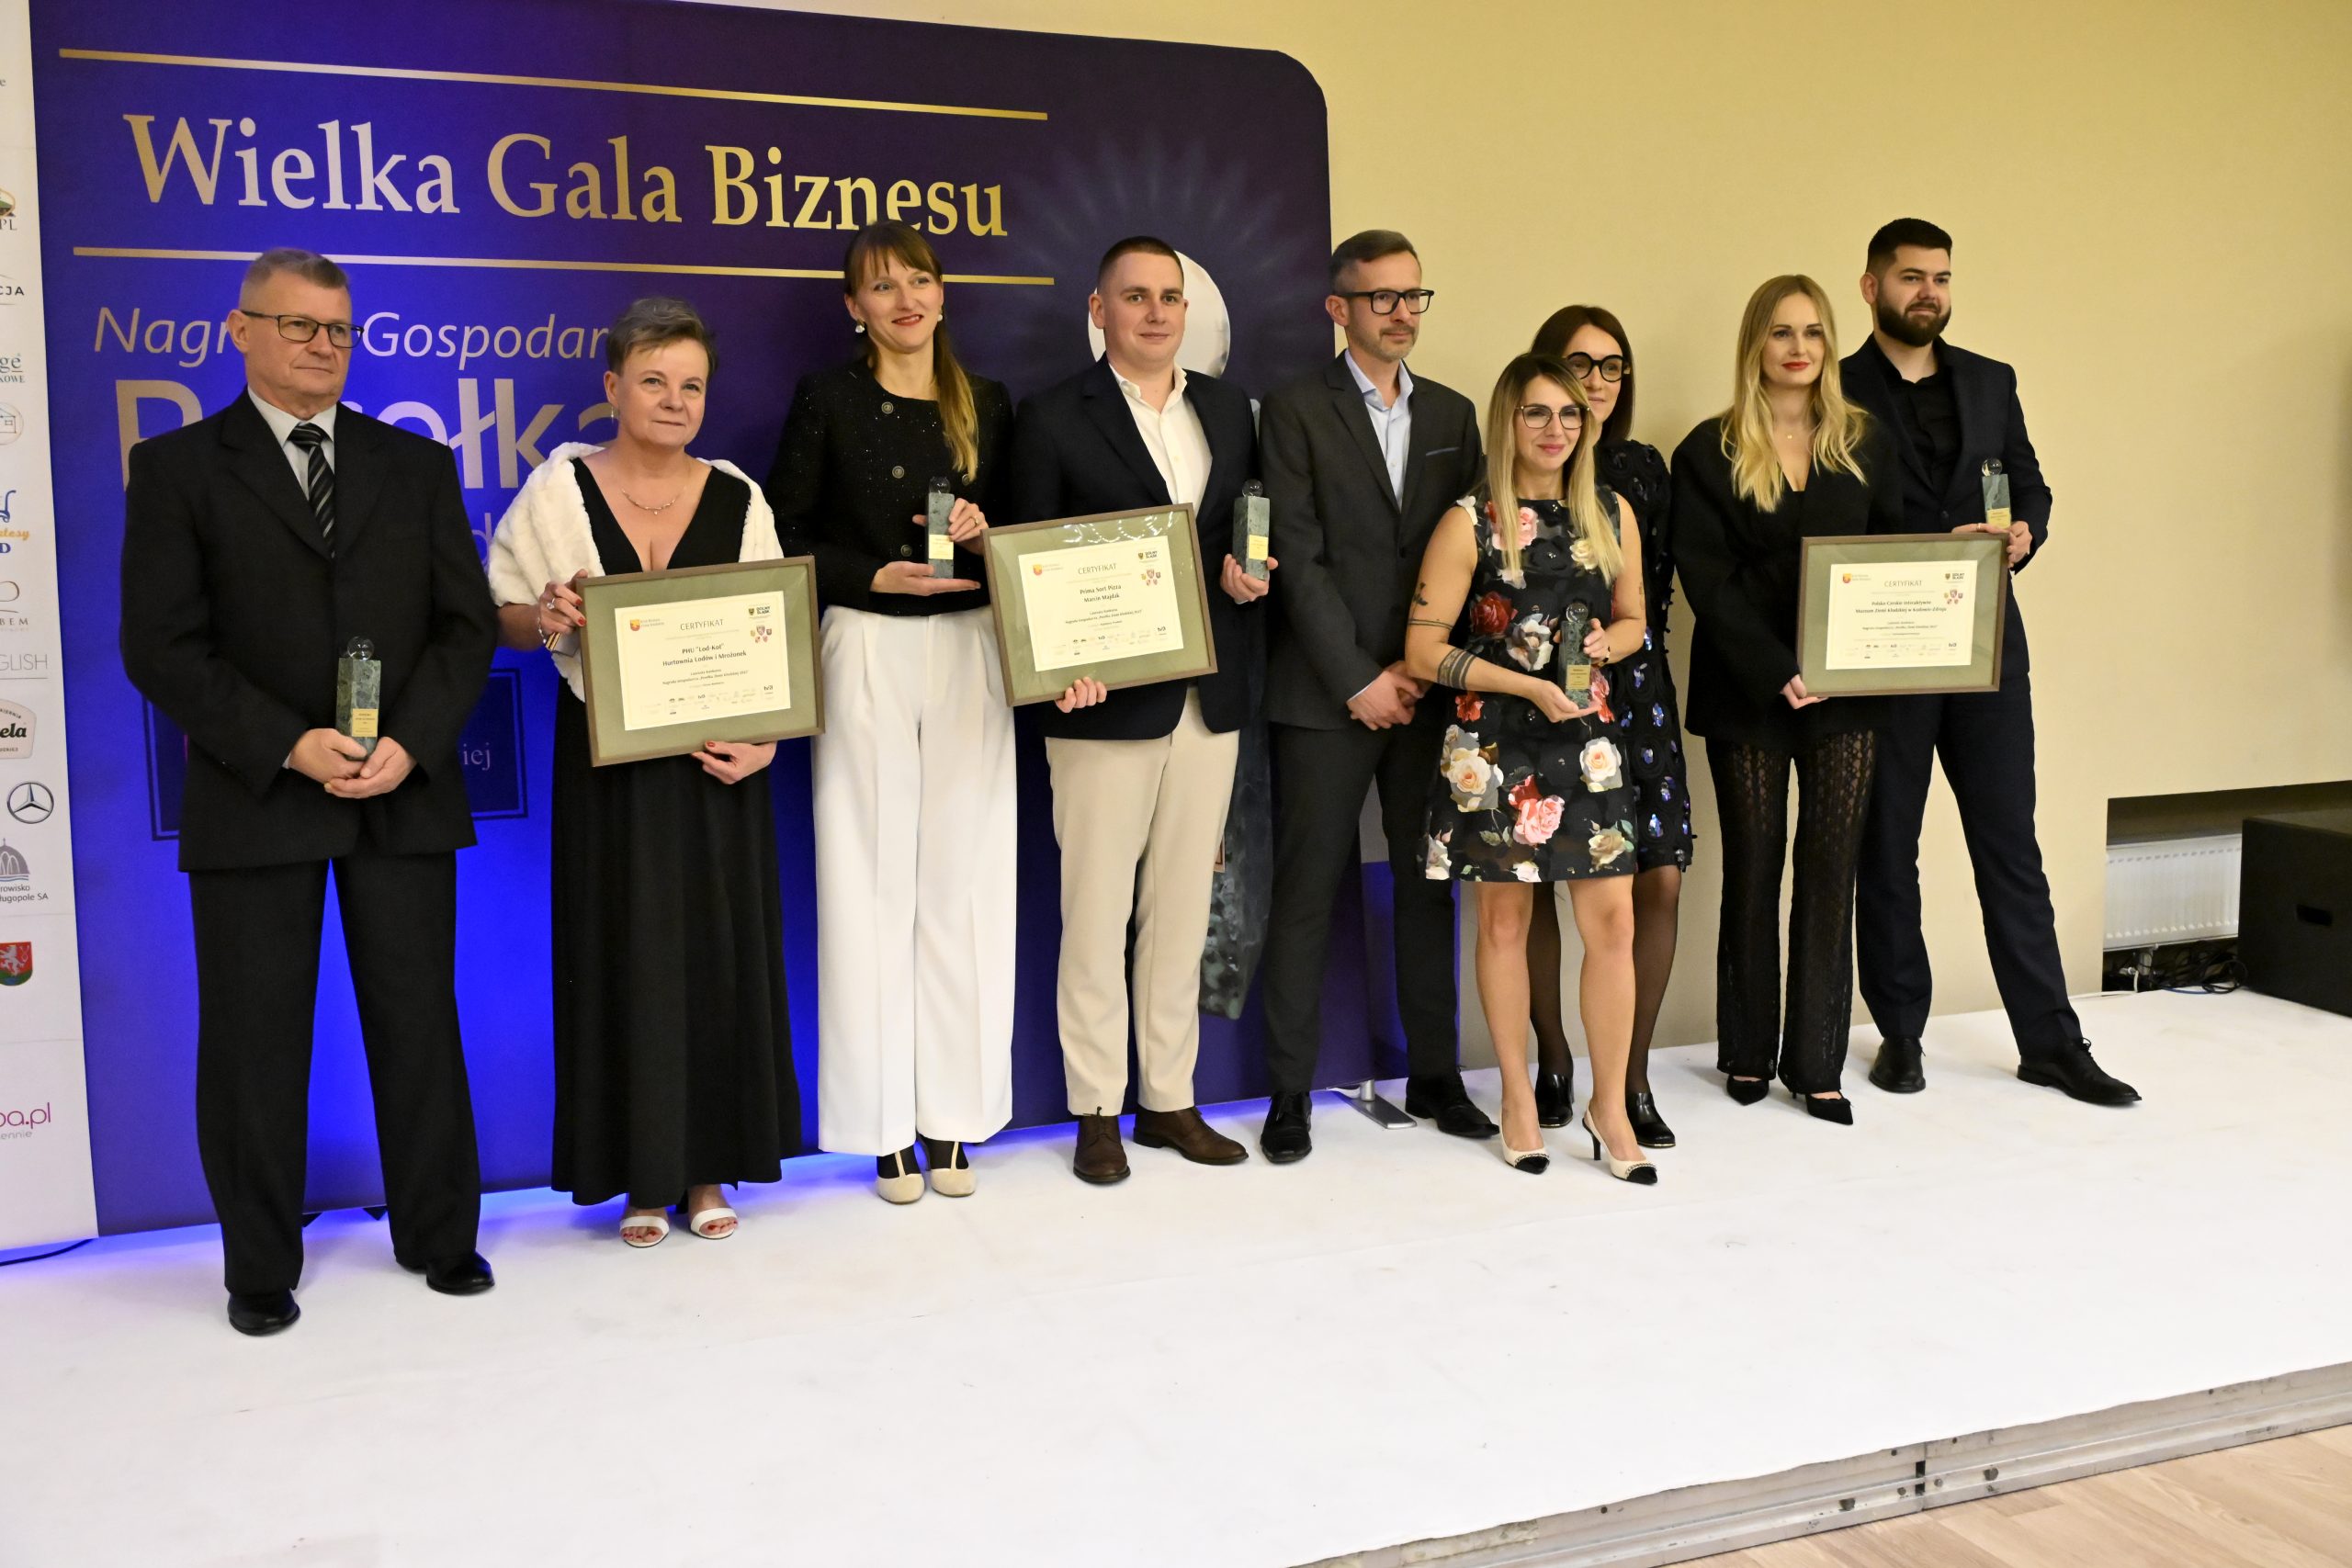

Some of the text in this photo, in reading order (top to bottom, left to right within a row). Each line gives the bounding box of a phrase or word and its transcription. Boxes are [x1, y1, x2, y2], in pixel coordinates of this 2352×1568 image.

[123, 113, 1009, 237] Wielka Gala Biznesu
[95, 307, 610, 370] Nagr Gospodar
[1078, 563, 1117, 575] CERTYFIKAT
[1883, 580, 1923, 588] CERTYFIKAT
[680, 618, 724, 631] CERTYFIKAT
[662, 658, 694, 667] Hurtownia
[37, 892, 49, 900] SA
